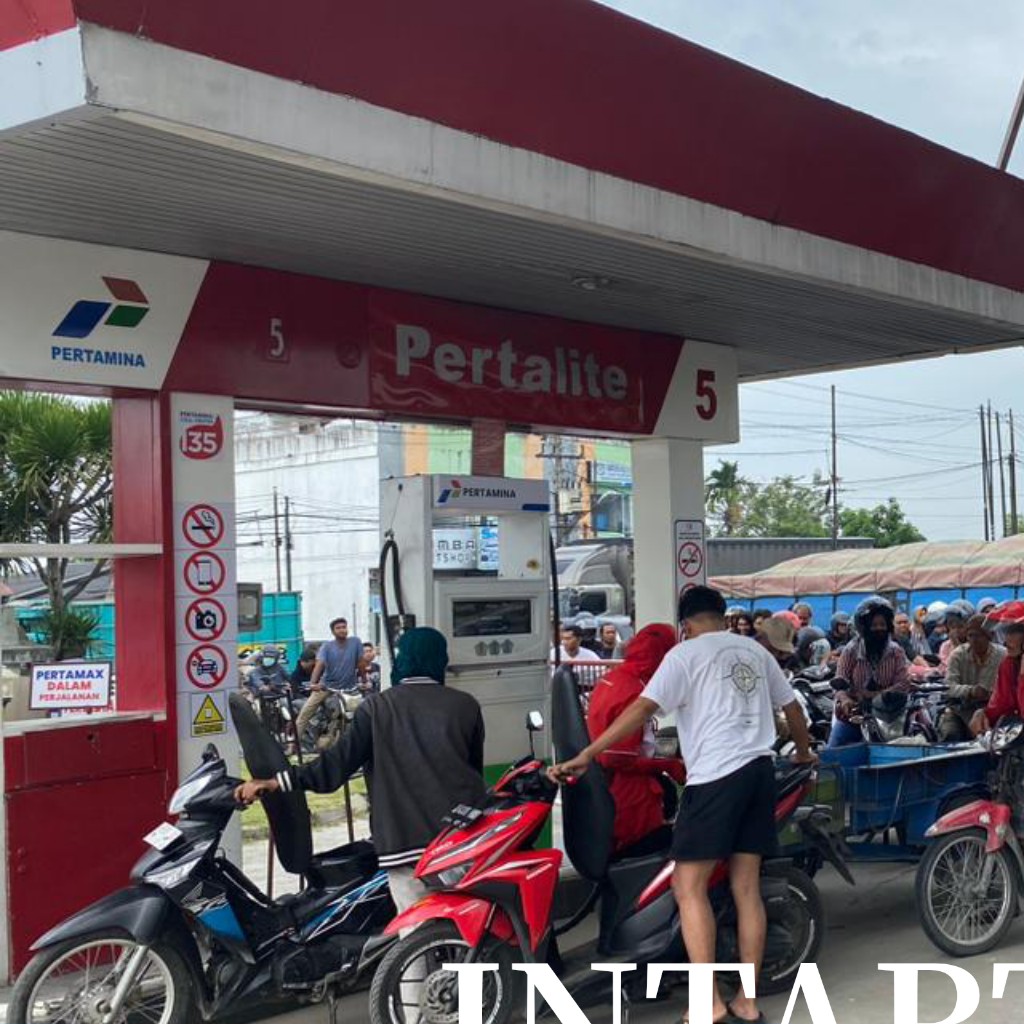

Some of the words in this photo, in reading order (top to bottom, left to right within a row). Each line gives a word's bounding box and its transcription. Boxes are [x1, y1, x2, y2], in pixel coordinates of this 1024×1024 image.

[269, 317, 286, 356] 5
[51, 346, 146, 368] PERTAMINA
[395, 323, 629, 400] Pertalite
[695, 369, 718, 421] 5
[182, 432, 218, 453] 135
[462, 487, 516, 499] PERTAMINA
[36, 669, 104, 680] PERTAMAX
[47, 681, 91, 691] DALAM
[39, 693, 101, 702] PERJALANAN
